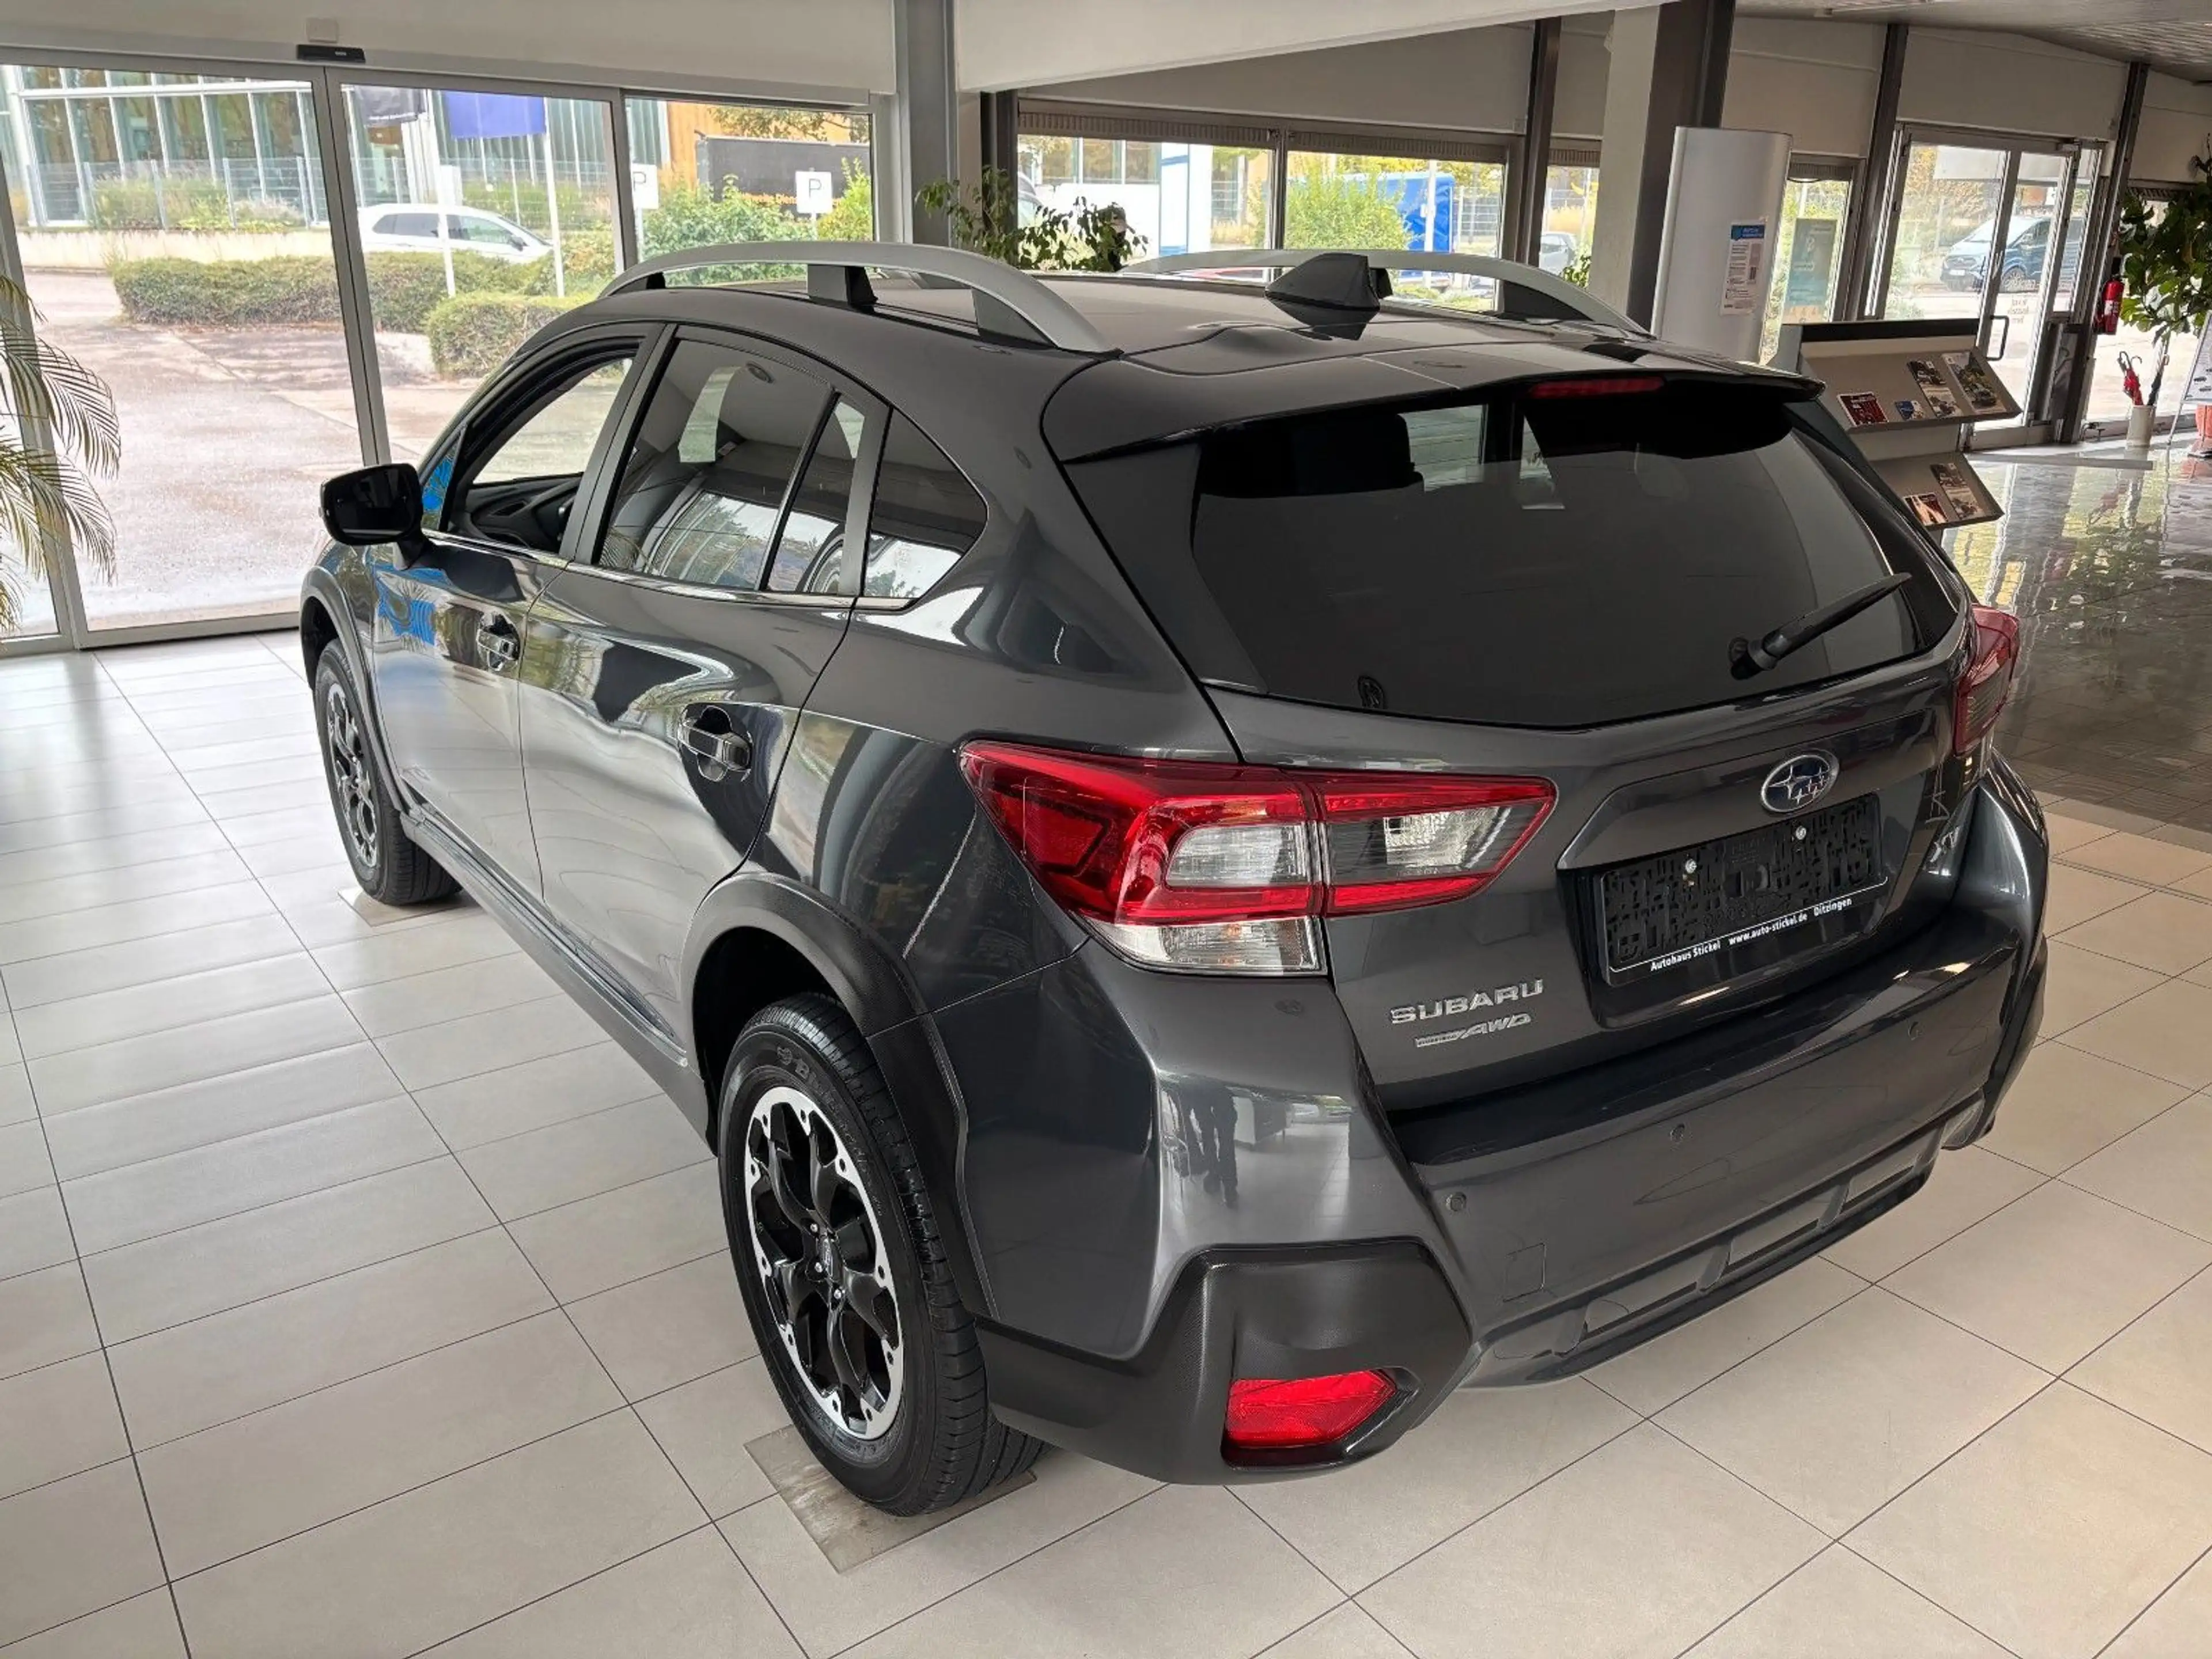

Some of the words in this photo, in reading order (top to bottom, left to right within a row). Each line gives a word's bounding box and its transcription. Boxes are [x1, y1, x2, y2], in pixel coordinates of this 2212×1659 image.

[632, 171, 647, 192] P
[808, 178, 823, 199] P
[1650, 952, 1692, 972] Autohaus
[1693, 940, 1721, 957] Stickel
[1728, 912, 1808, 946] www.auto-stickel.de
[1813, 897, 1853, 916] Ditzingen
[1389, 978, 1544, 1025] SUBARU
[1460, 1012, 1532, 1040] AWD
